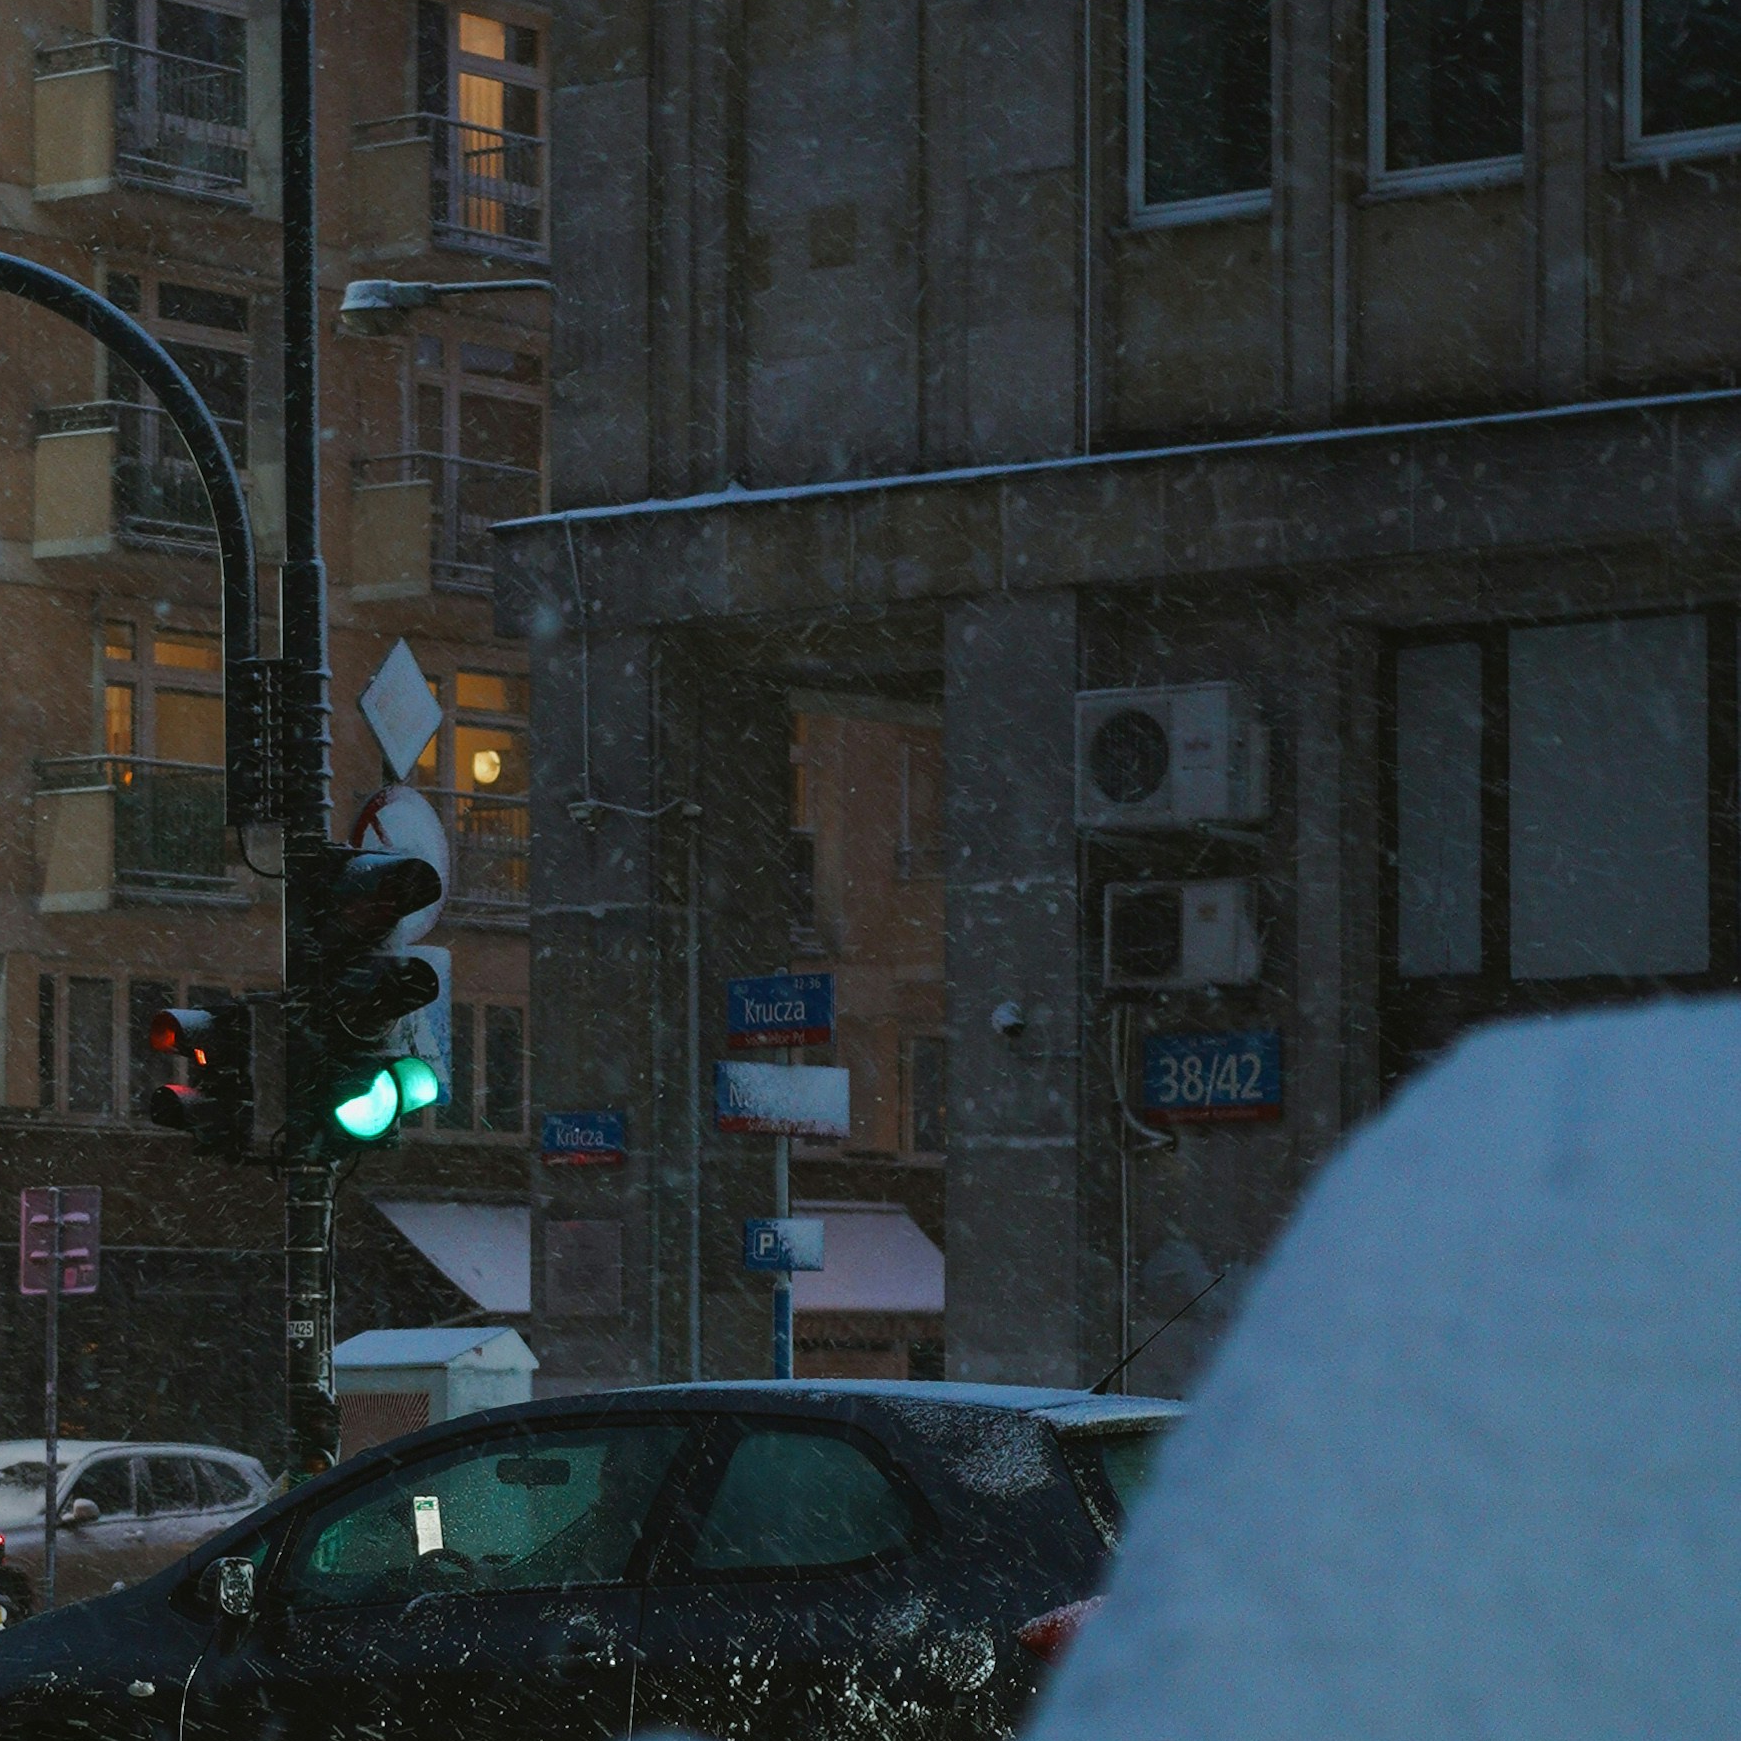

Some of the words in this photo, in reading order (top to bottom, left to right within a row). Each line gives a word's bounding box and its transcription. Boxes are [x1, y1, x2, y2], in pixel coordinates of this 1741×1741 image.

[744, 997, 806, 1024] Krucza
[1159, 1052, 1263, 1106] 38/42
[556, 1126, 604, 1147] Krucza
[760, 1233, 774, 1255] P
